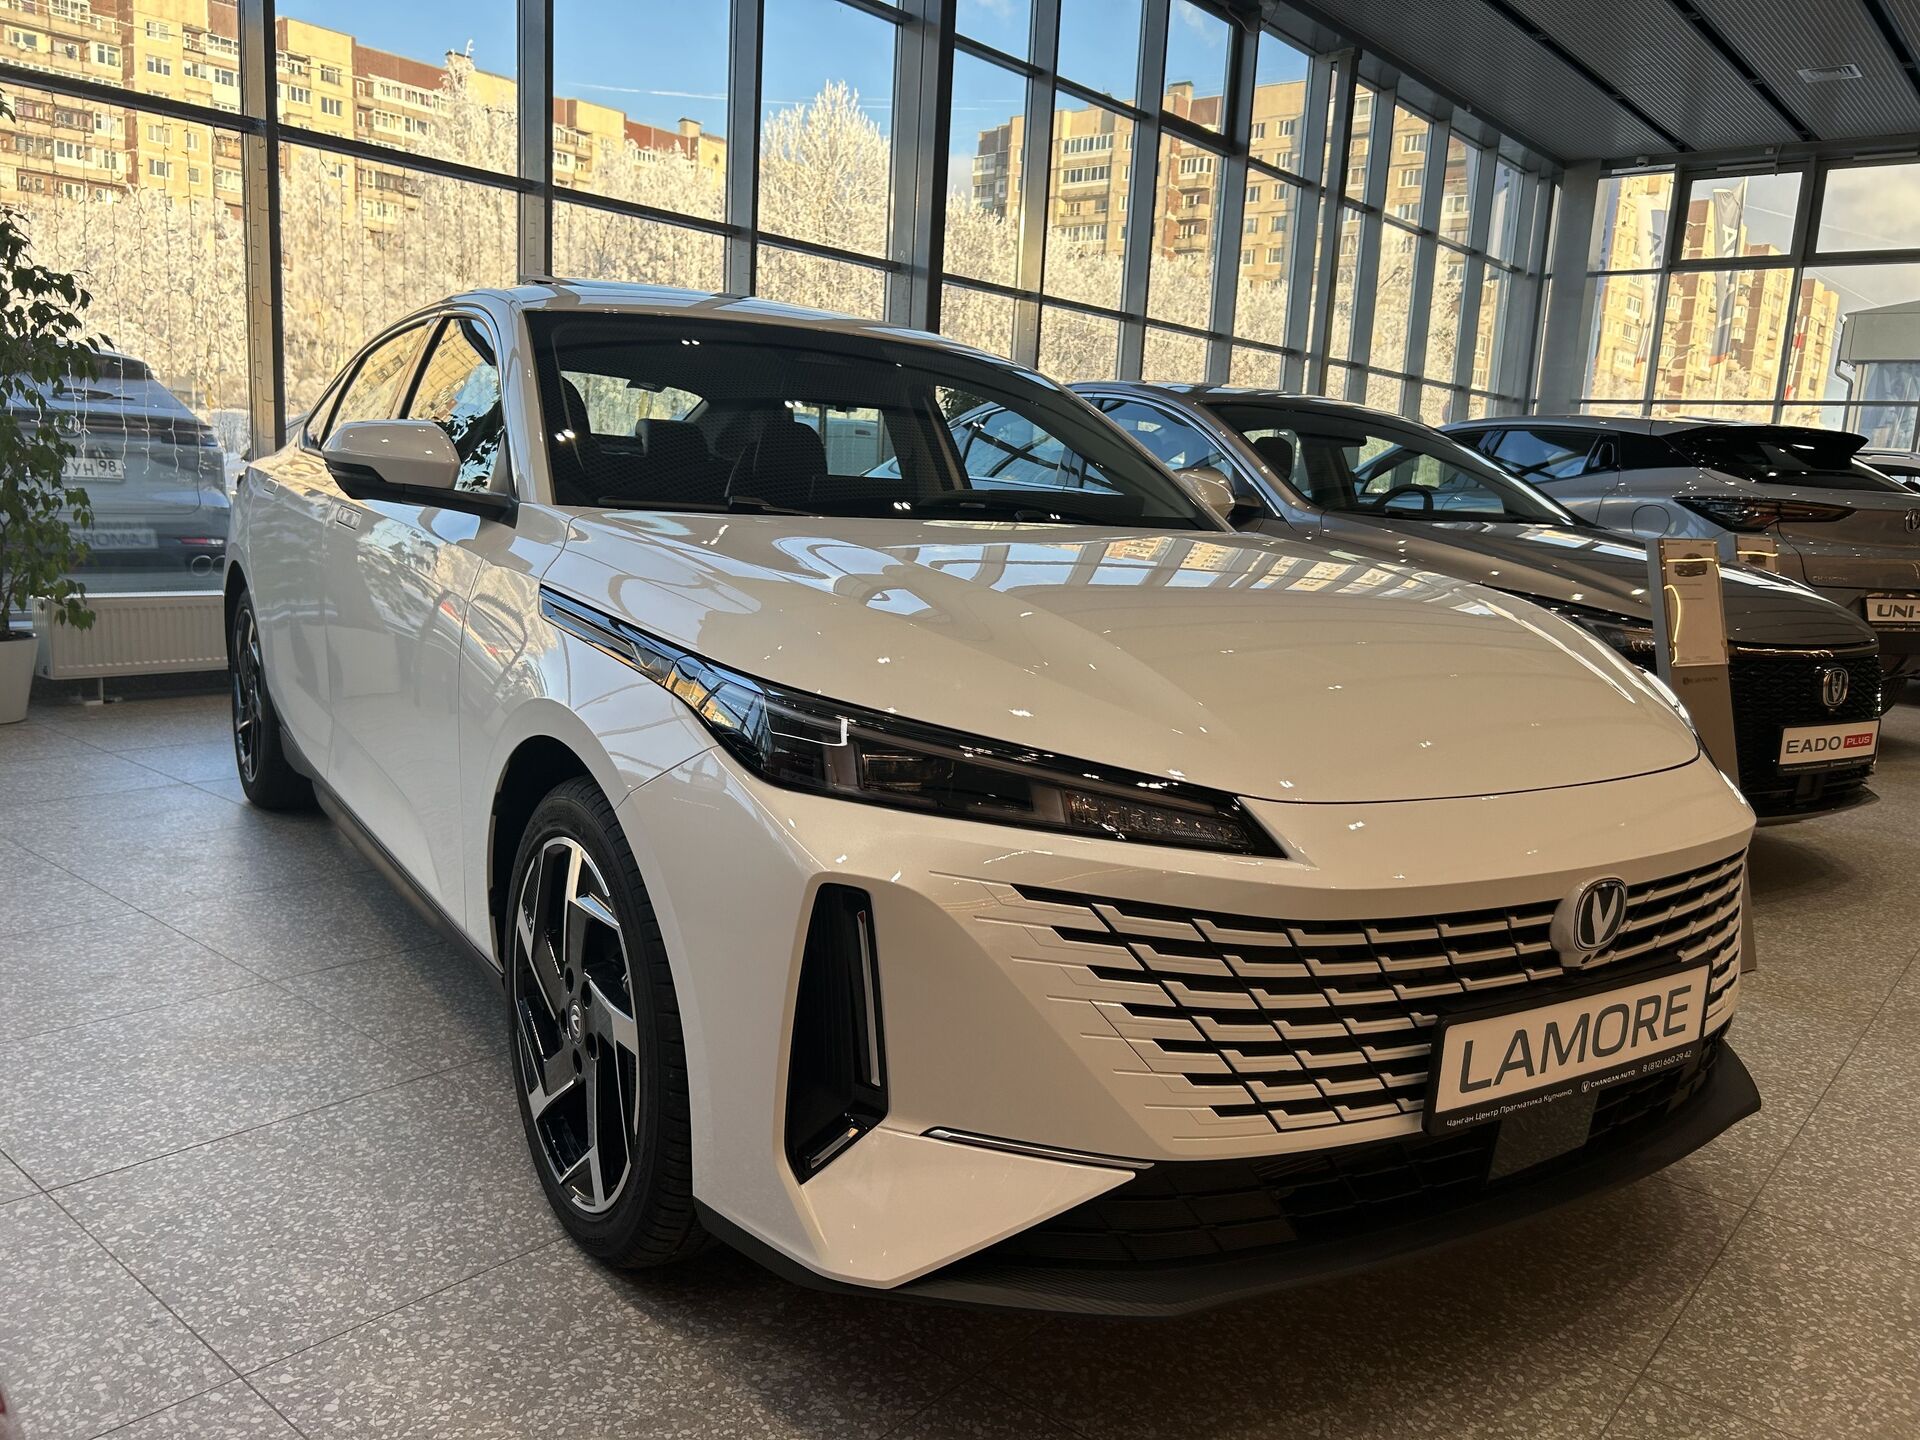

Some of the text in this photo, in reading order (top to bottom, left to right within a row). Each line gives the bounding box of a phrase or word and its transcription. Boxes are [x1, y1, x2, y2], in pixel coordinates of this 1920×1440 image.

[98, 460, 117, 472] 98
[1786, 735, 1871, 754] EADO PLUS
[1459, 984, 1692, 1094] LAMORE
[1642, 1065, 1648, 1073] 8
[1648, 1059, 1663, 1071] (812)
[1590, 1069, 1636, 1088] CHANGAN AUTO
[1446, 1088, 1573, 1127] Чанган Центр Прагматика Купчино
